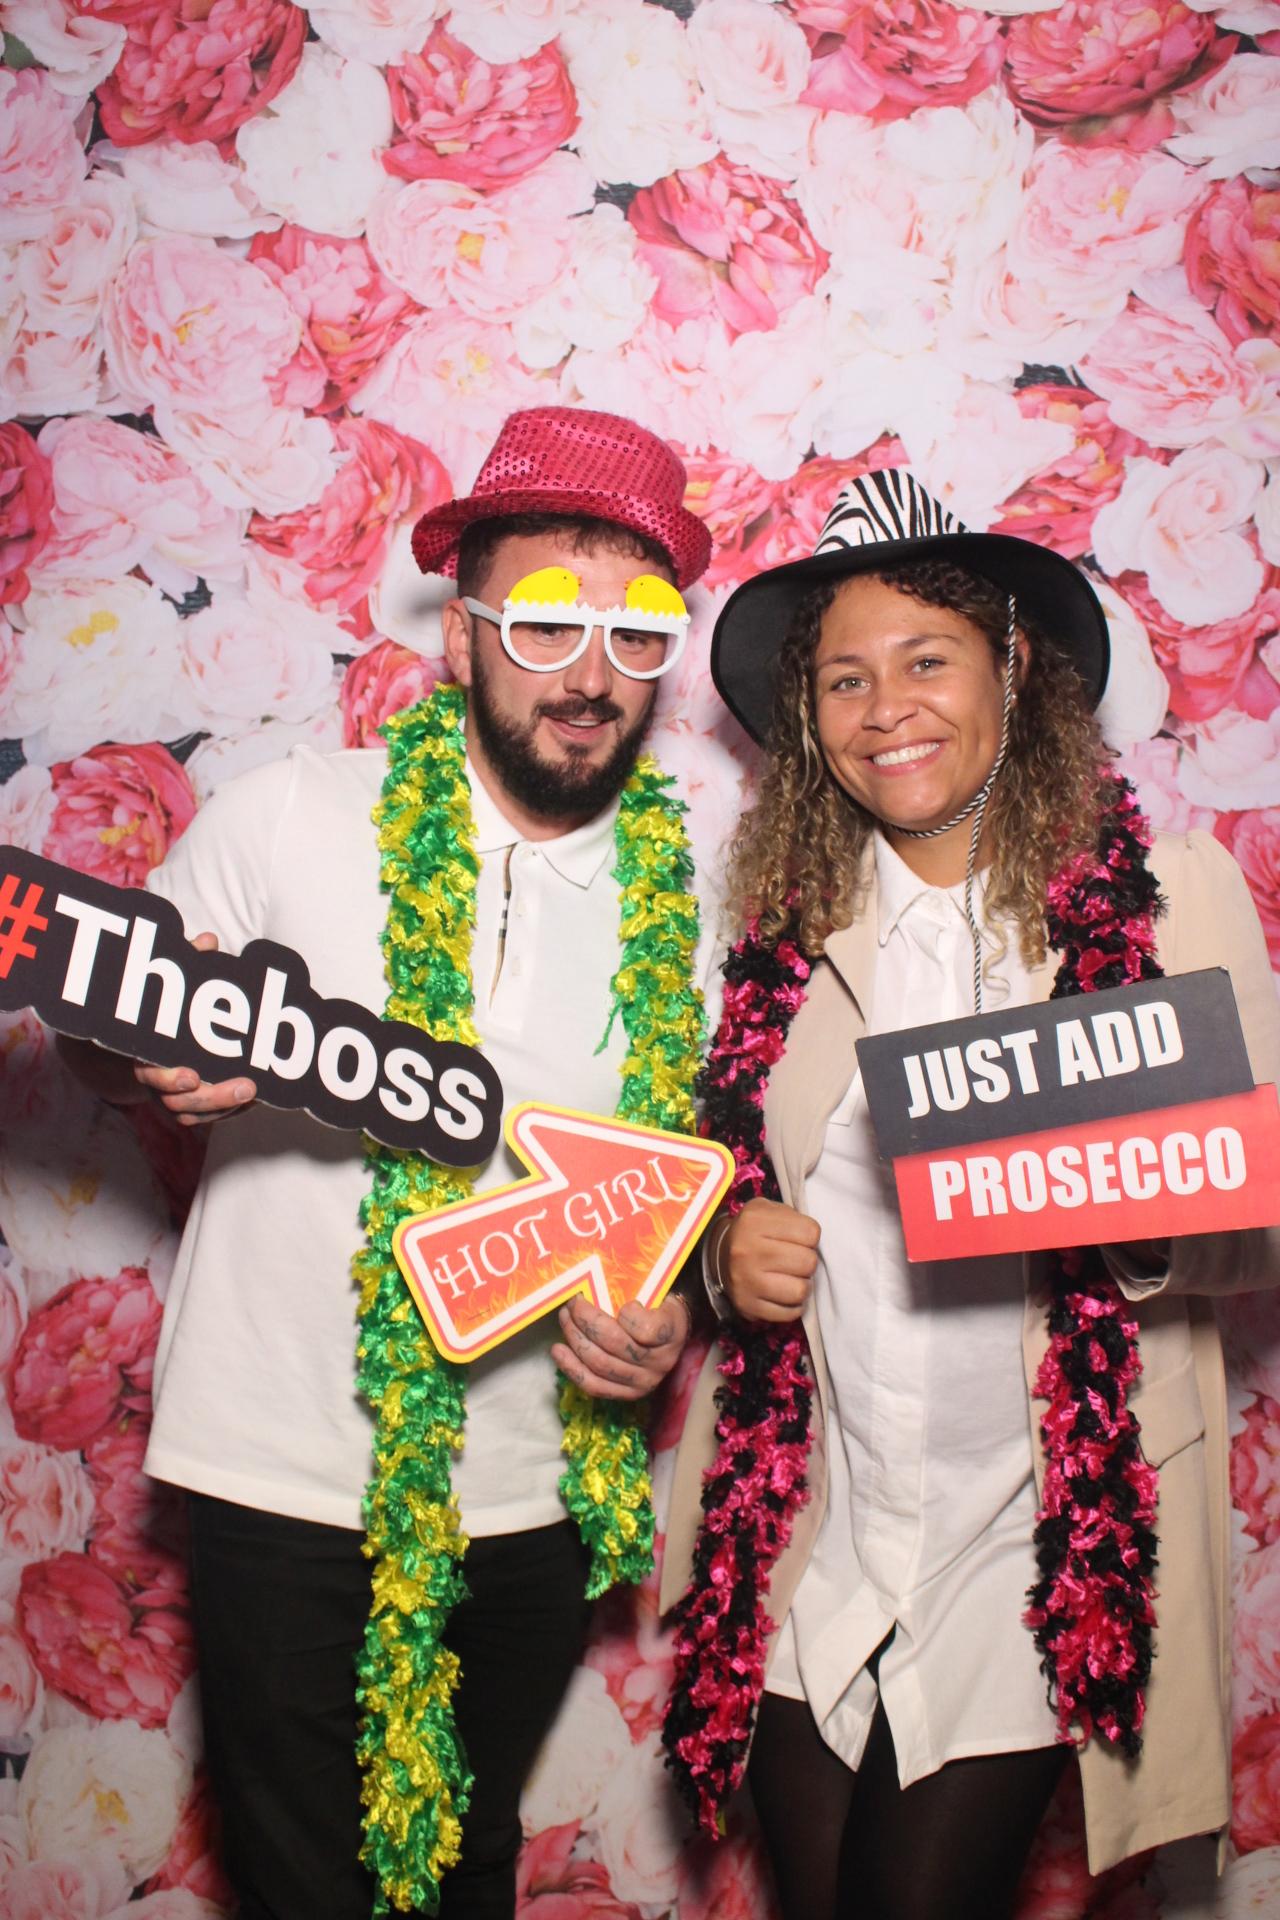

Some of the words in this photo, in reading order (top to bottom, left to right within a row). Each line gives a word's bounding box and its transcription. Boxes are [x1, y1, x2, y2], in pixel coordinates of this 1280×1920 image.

[0, 874, 487, 1141] #Theboss
[902, 1029, 1040, 1119] JUST
[1056, 1001, 1184, 1087] ADD
[433, 1209, 552, 1300] HOT
[563, 1156, 693, 1240] GIRL
[928, 1126, 1247, 1222] PROSECCO
